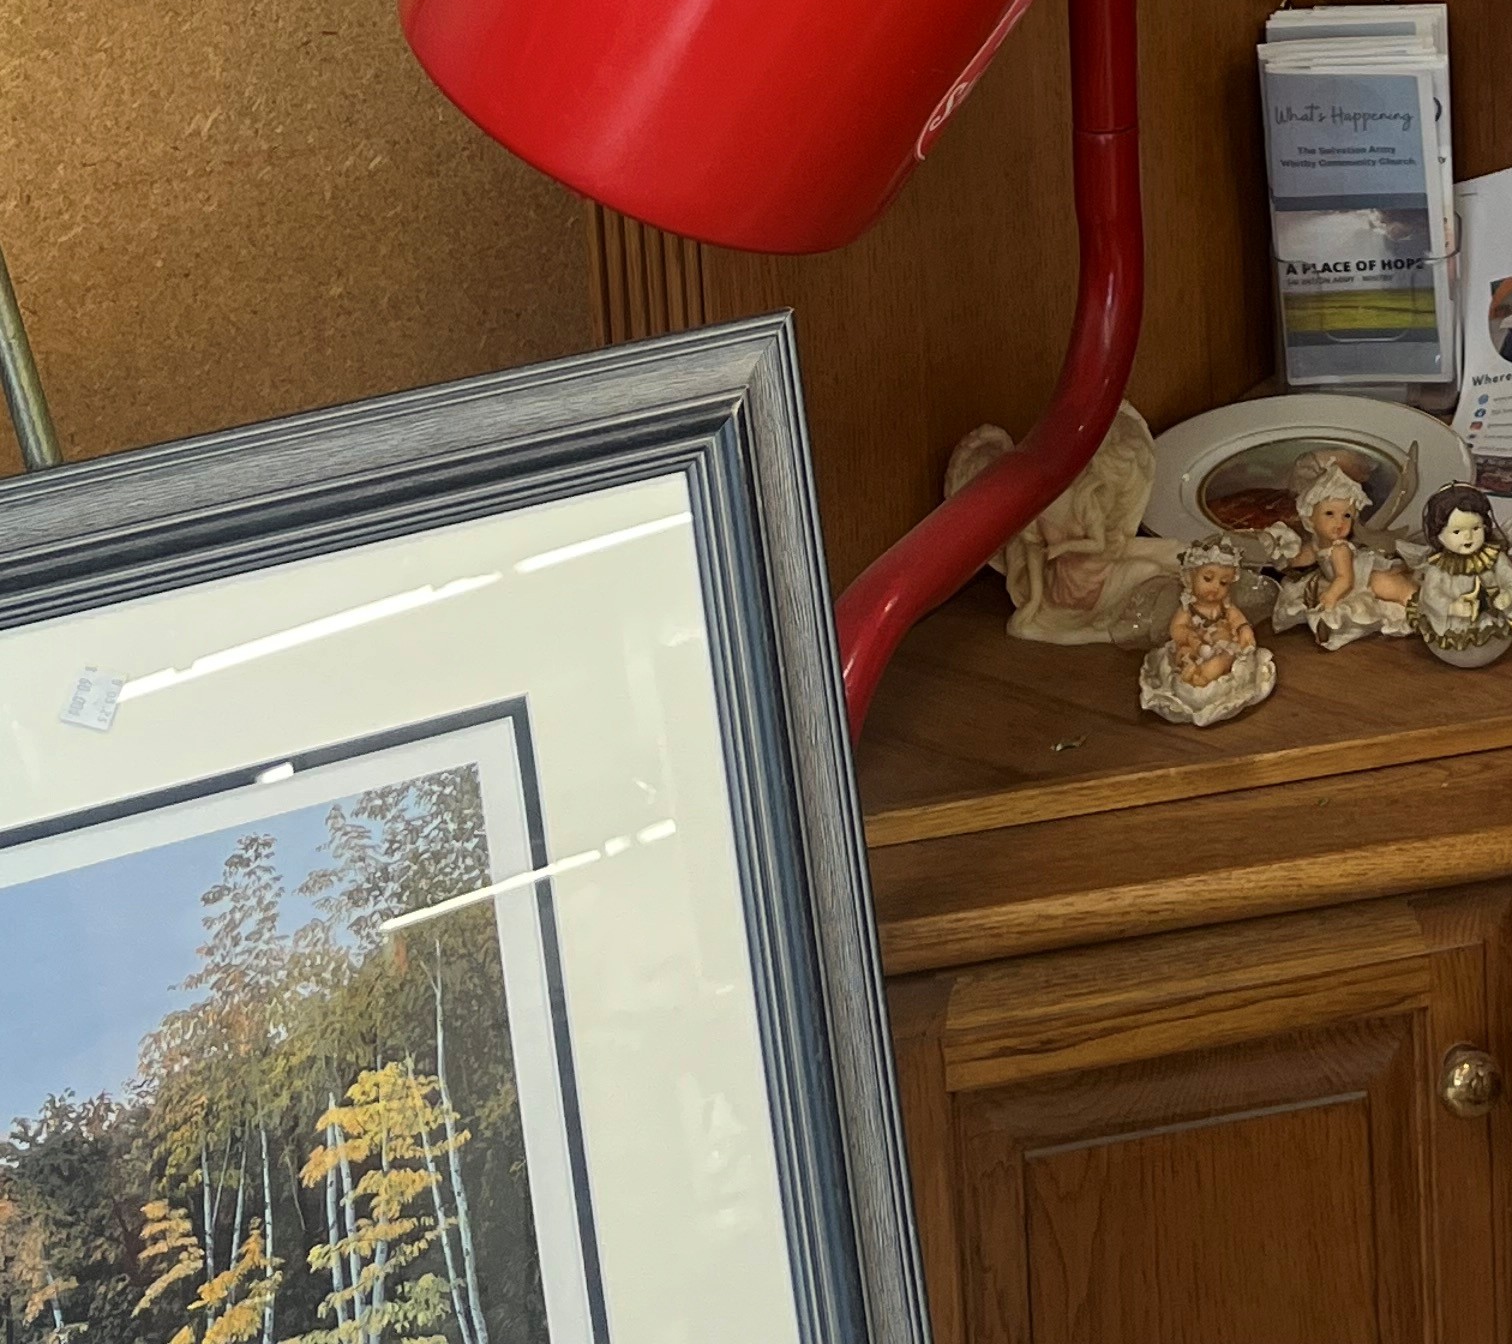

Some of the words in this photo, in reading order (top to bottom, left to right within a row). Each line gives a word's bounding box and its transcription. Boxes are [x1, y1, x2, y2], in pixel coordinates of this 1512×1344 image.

[1332, 106, 1414, 131] Happening
[1286, 263, 1298, 276] A
[1302, 261, 1351, 275] PLACE
[1356, 260, 1376, 272] OF
[1472, 374, 1512, 387] Where
